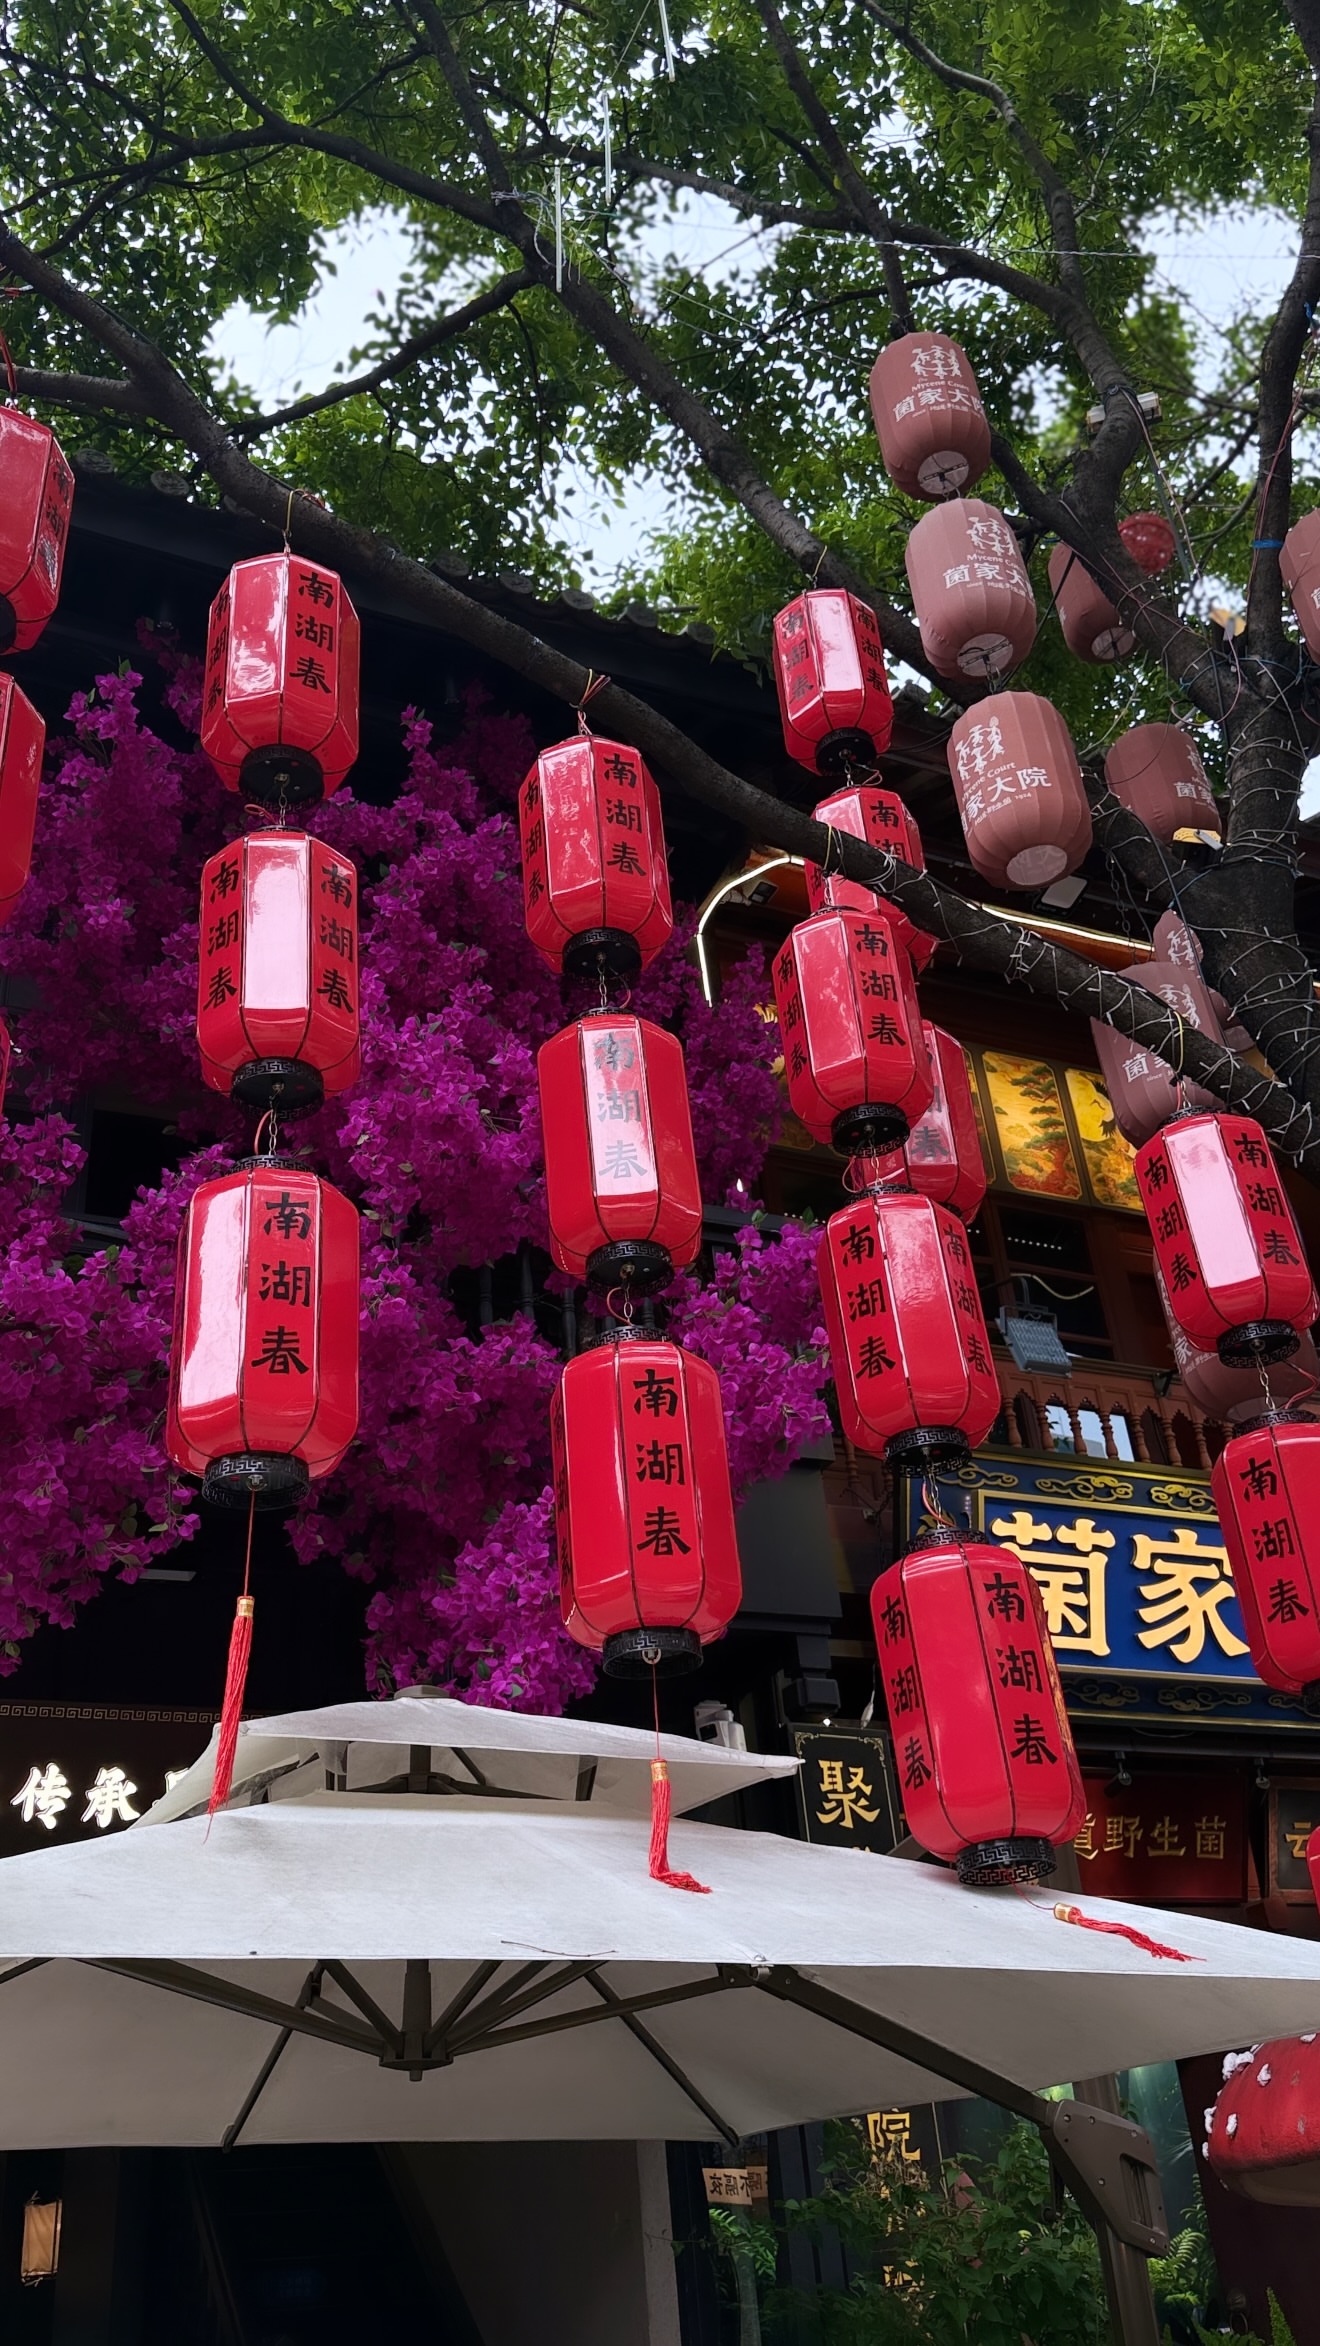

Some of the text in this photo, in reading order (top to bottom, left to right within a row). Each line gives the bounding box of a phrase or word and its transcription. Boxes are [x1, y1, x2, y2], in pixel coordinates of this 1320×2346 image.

[942, 562, 1035, 600] 菌家大
[966, 553, 1003, 564] Mycene
[289, 572, 336, 694] 南湖春
[855, 602, 889, 697] 南湖春
[602, 753, 647, 877] 南湖春
[986, 762, 1017, 778] Court
[523, 780, 545, 909] 南湖春
[203, 858, 240, 1013] 南湖春
[317, 864, 355, 1014] 南湖春
[854, 923, 907, 1047] 南湖春
[777, 953, 808, 1080] 南湖春
[592, 1031, 648, 1180] 南湖春
[1143, 1155, 1198, 1294] 南湖春
[1234, 1132, 1301, 1267] 南湖春
[251, 1191, 313, 1376] 南湖春
[839, 1223, 896, 1380] 南湖春
[944, 1223, 993, 1378] 南湖春
[633, 1369, 692, 1557] 南湖春
[991, 1510, 1251, 1664] 菌家
[1239, 1457, 1310, 1625] 南湖春
[880, 1595, 933, 1792] 南湖春
[983, 1572, 1059, 1767] 南湖春
[10, 1762, 191, 1830] 传承
[816, 1759, 881, 1829] 聚
[866, 2107, 921, 2163] 院
